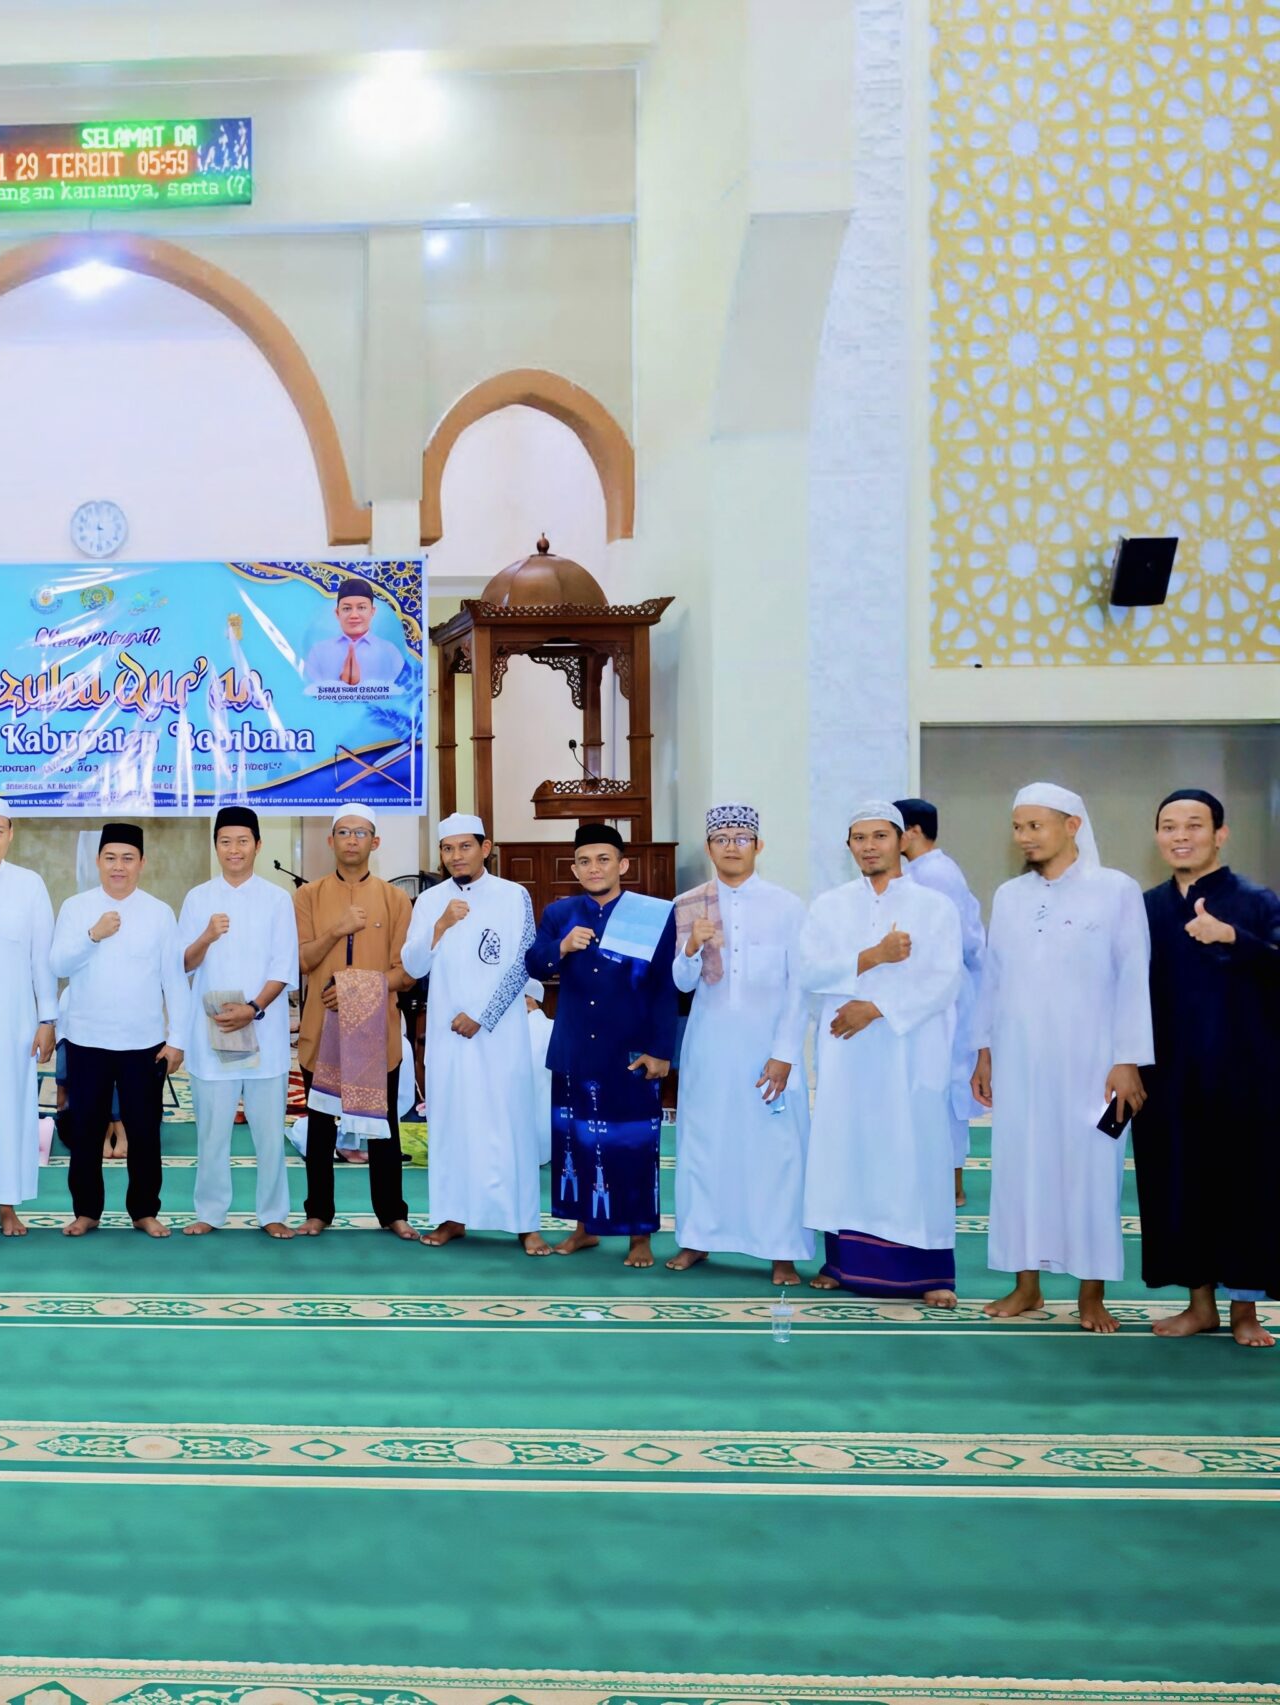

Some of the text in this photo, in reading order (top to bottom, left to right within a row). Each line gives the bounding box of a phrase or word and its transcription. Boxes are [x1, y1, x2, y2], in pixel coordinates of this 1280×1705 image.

[81, 126, 165, 149] SELAMAT
[15, 152, 39, 180] 29
[46, 151, 124, 178] TERBIT
[137, 149, 188, 175] 05:59
[167, 179, 219, 197] serta
